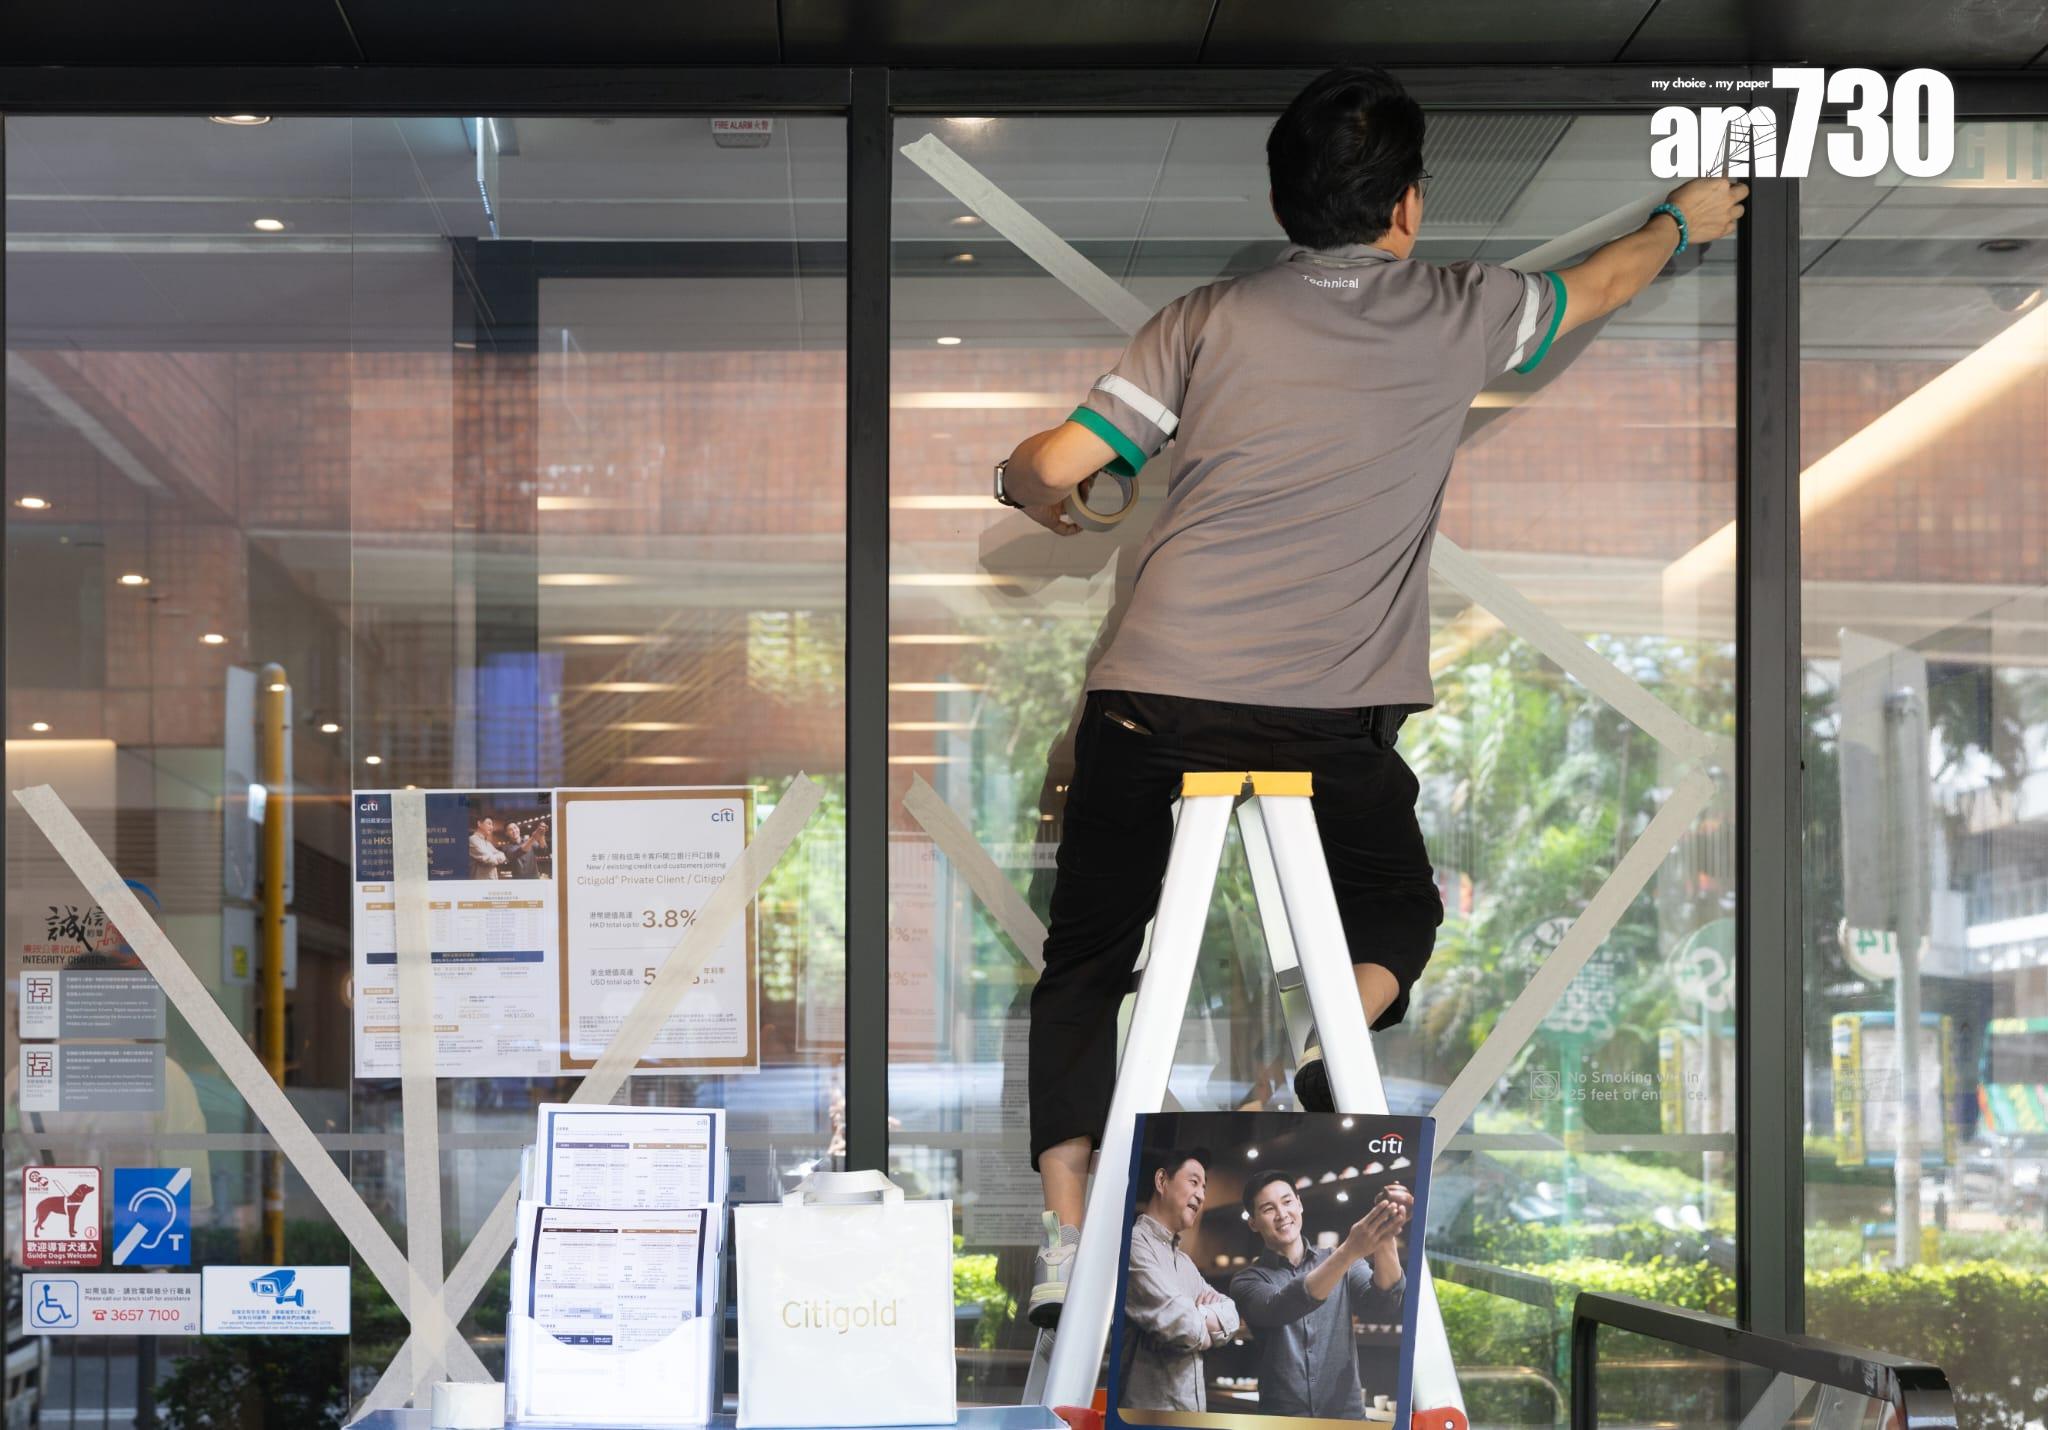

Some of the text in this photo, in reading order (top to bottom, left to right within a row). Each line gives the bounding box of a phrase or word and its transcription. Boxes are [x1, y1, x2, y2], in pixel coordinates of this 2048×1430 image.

[1301, 273, 1359, 289] Technical
[360, 800, 378, 811] citi
[711, 808, 734, 822] citi
[703, 862, 726, 870] joining
[621, 875, 654, 885] Private
[656, 875, 685, 885] Client
[694, 874, 725, 887] Citigol
[642, 910, 697, 928] 3.8%
[22, 955, 65, 964] INTEGRITY
[1567, 1072, 1587, 1084] No
[1591, 1072, 1652, 1086] Smoking
[1569, 1089, 1586, 1100] 25
[1590, 1088, 1619, 1100] feet
[1623, 1089, 1637, 1100] of
[1368, 1133, 1404, 1154] citi
[27, 1242, 97, 1252] 歡迎導盲犬進入
[111, 1309, 180, 1321] 3657 7100
[782, 1299, 897, 1335] Citigold
